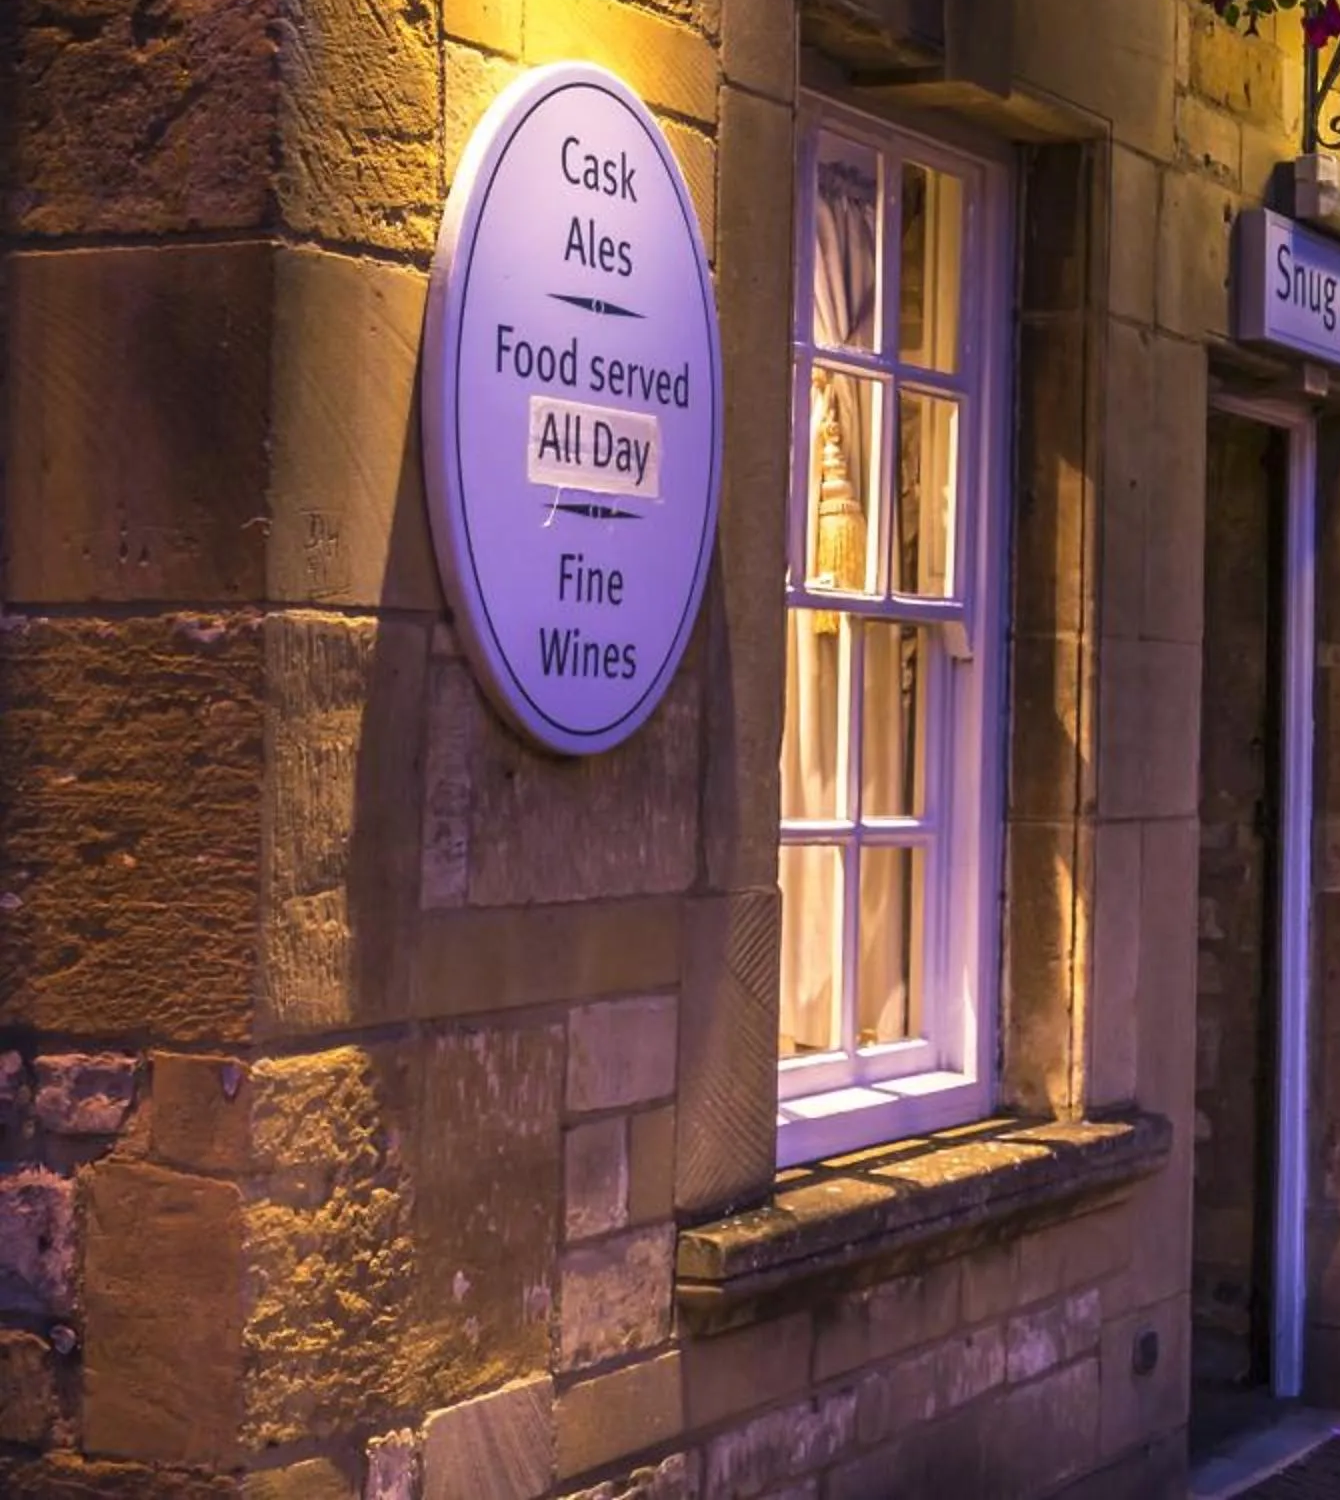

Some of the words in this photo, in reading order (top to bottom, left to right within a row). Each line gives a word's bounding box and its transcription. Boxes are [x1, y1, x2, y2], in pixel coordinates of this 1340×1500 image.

[561, 135, 637, 203] Cask
[564, 215, 633, 277] Ales
[1276, 243, 1337, 332] Snug
[496, 324, 578, 388] Food
[589, 354, 690, 408] served
[538, 412, 582, 466] All
[592, 421, 651, 484] Day
[558, 553, 624, 606] Fine
[540, 627, 636, 680] Wines
